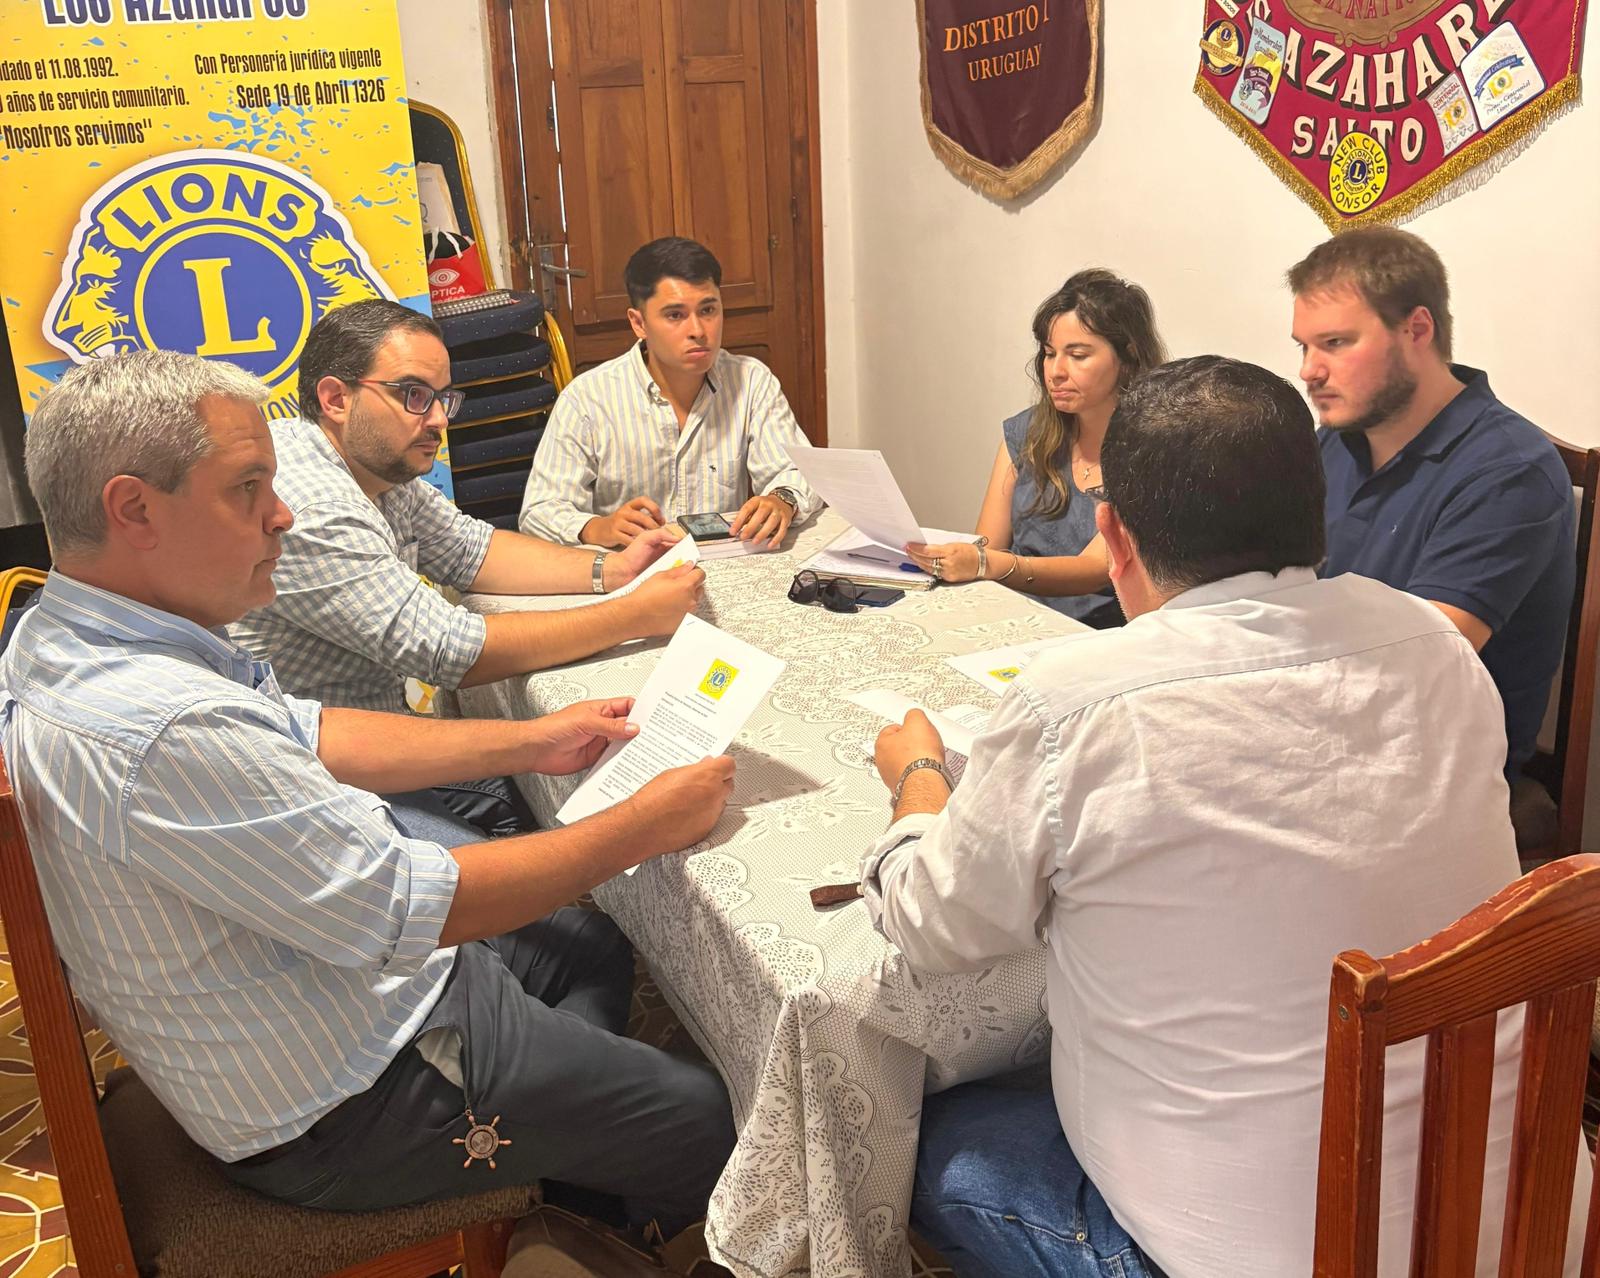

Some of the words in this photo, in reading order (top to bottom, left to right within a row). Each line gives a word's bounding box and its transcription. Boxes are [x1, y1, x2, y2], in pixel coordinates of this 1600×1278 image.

[943, 4, 1039, 52] DISTRITO
[0, 60, 33, 81] dado
[35, 59, 48, 80] el
[49, 57, 119, 79] 11.08.1992.
[194, 54, 218, 75] Con
[220, 50, 287, 74] Personería
[289, 49, 337, 72] jurídica
[339, 47, 382, 70] vigente
[967, 44, 1042, 81] URUGUAY
[6, 91, 37, 113] años
[39, 91, 55, 111] de
[57, 88, 110, 111] servicio
[112, 85, 190, 108] comunitario.
[236, 84, 271, 109] Sede
[274, 83, 291, 107] 19
[294, 82, 311, 106] de
[315, 80, 350, 105] Abril
[352, 78, 385, 103] 1326
[1333, 136, 1357, 167] NEW
[1361, 137, 1386, 174] CLUB
[1352, 163, 1363, 179] L
[111, 173, 306, 242] LIONS
[1331, 174, 1381, 209] SPONSOR
[183, 257, 277, 356] L
